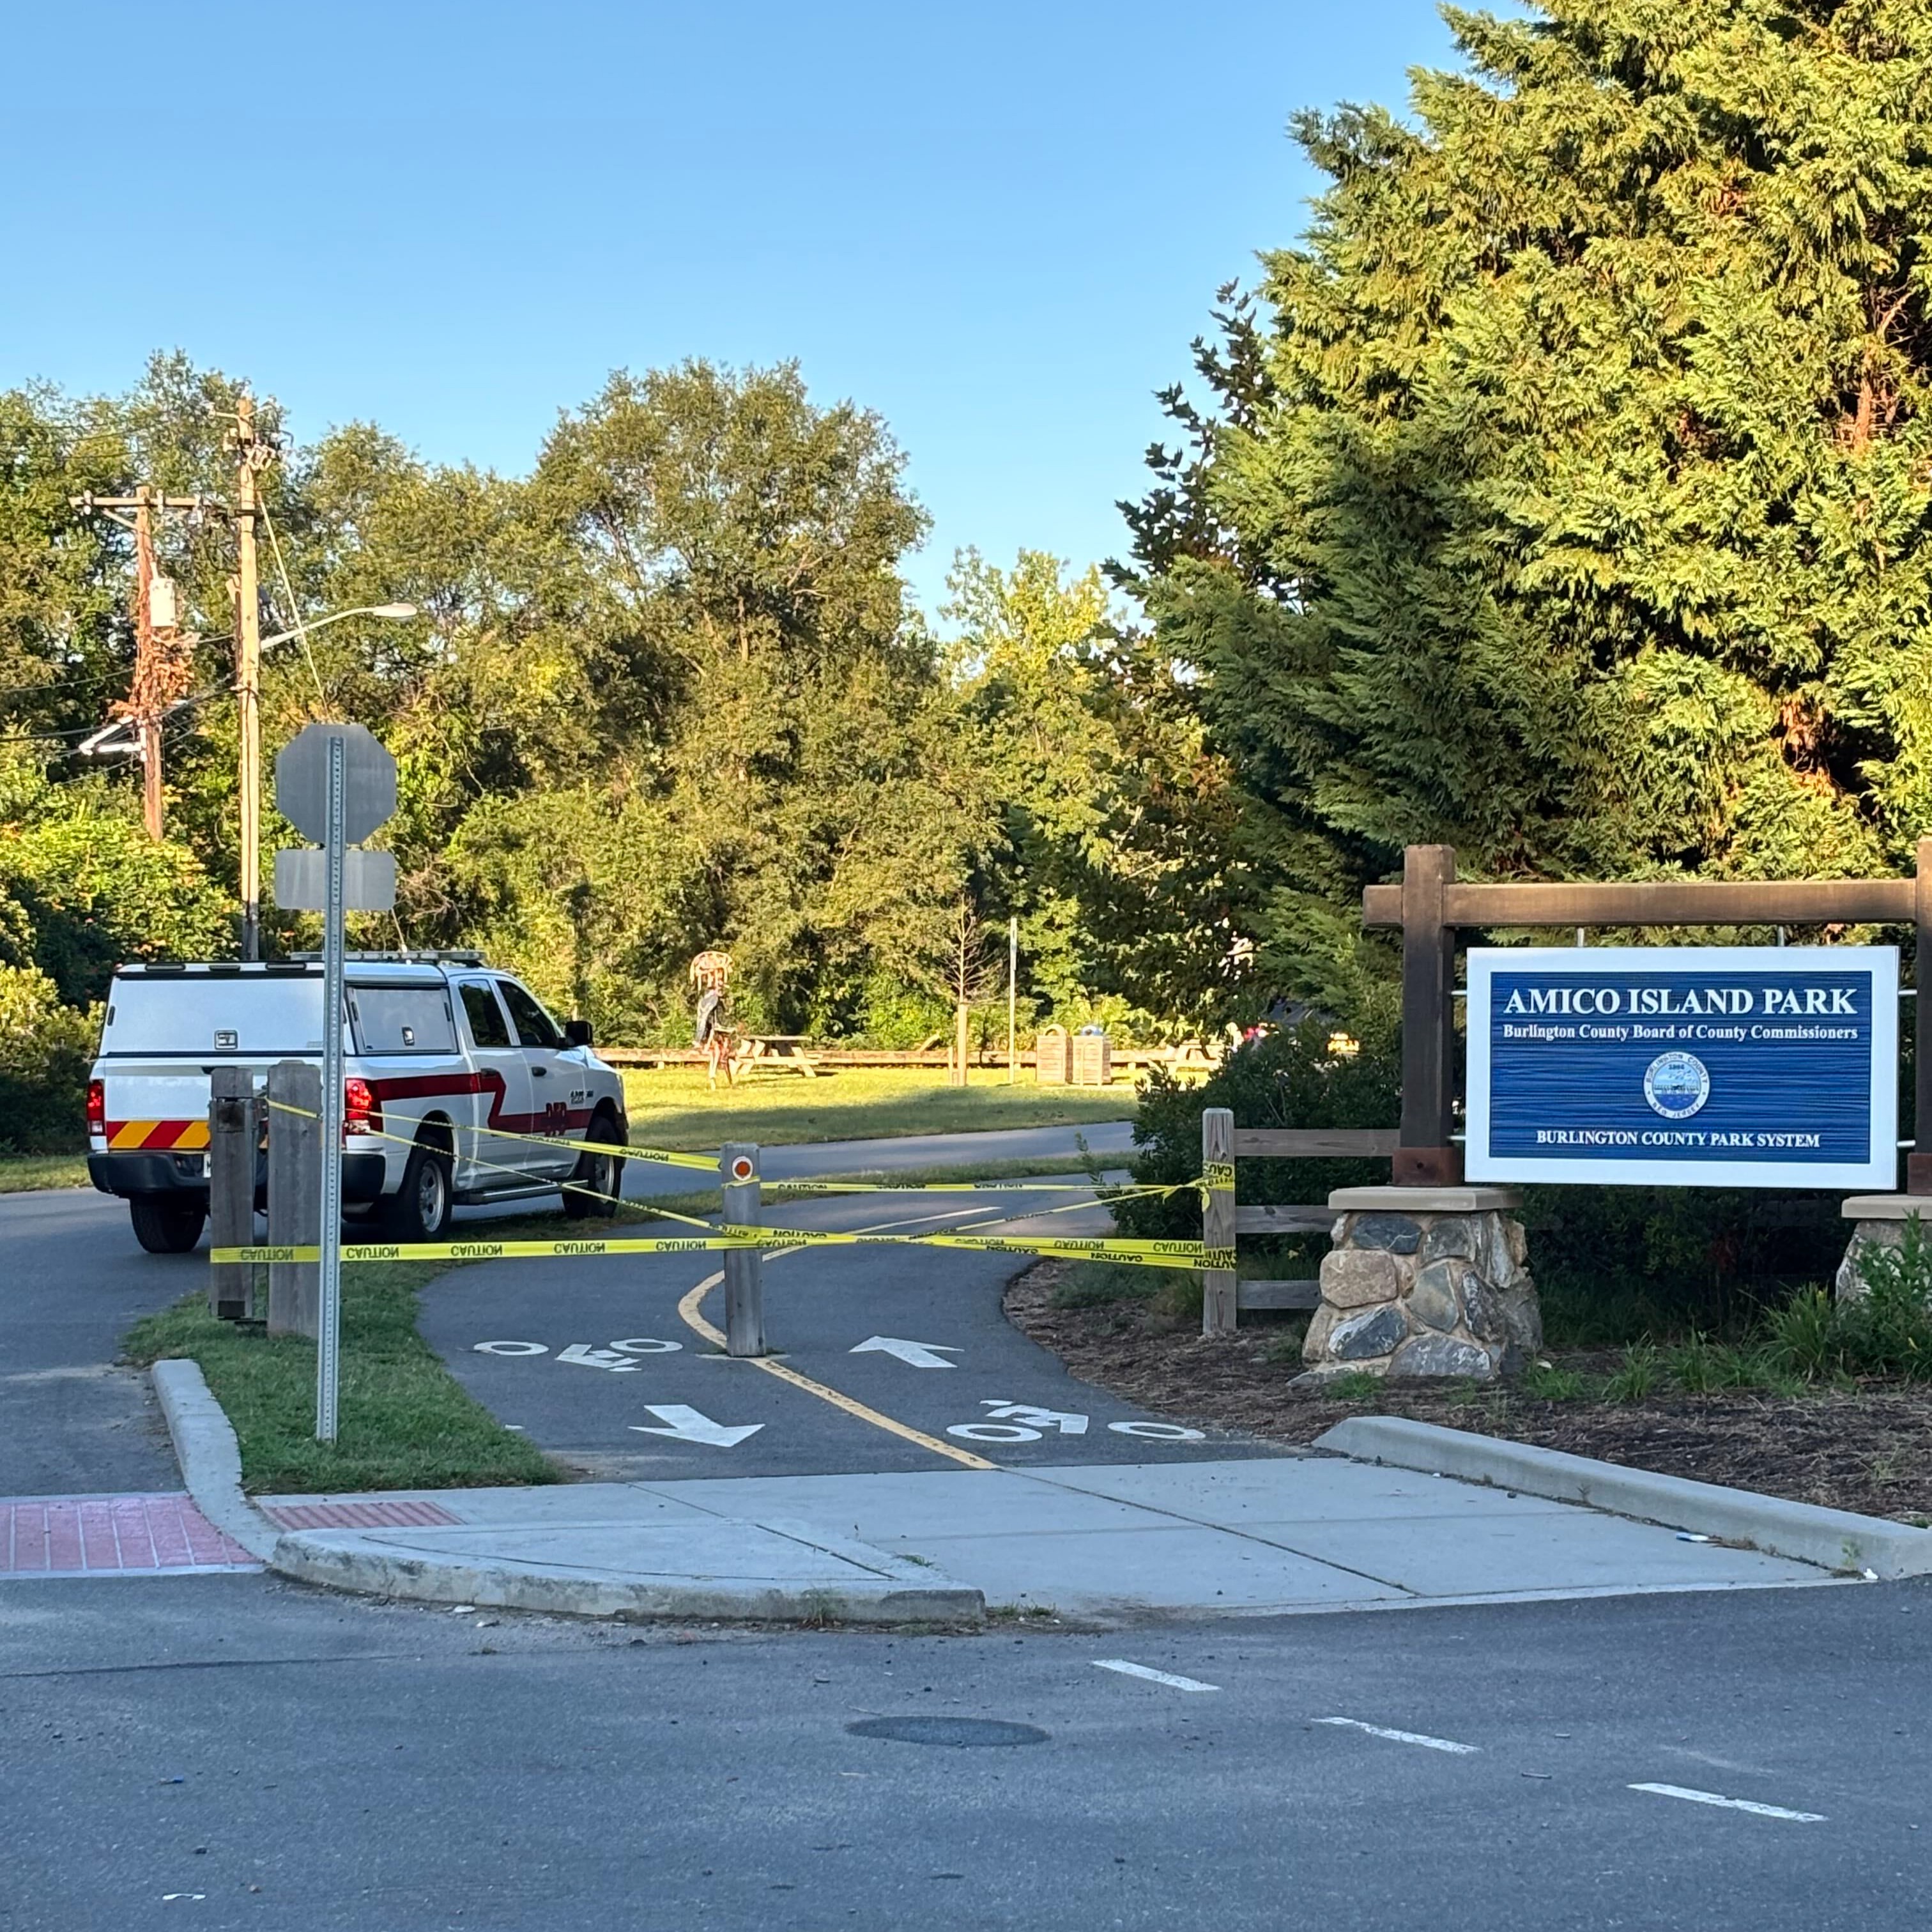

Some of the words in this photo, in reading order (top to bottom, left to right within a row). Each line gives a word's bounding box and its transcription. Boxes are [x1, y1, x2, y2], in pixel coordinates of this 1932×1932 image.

[1503, 988, 1620, 1015] AMICO
[1627, 988, 1754, 1015] ISLAND
[1761, 988, 1858, 1015] PARK
[1503, 1024, 1575, 1041] Burlington
[1579, 1024, 1629, 1041] County
[1633, 1024, 1675, 1039] Board
[1679, 1024, 1694, 1039] of
[1696, 1025, 1747, 1042] County
[1751, 1025, 1858, 1039] Commissioners
[1537, 1130, 1638, 1144] BURLINGTON
[1641, 1131, 1707, 1146] COUNTY
[1710, 1133, 1754, 1146] PARK
[1757, 1133, 1820, 1147] SYSTEM
[1193, 1257, 1237, 1269] AUTION
